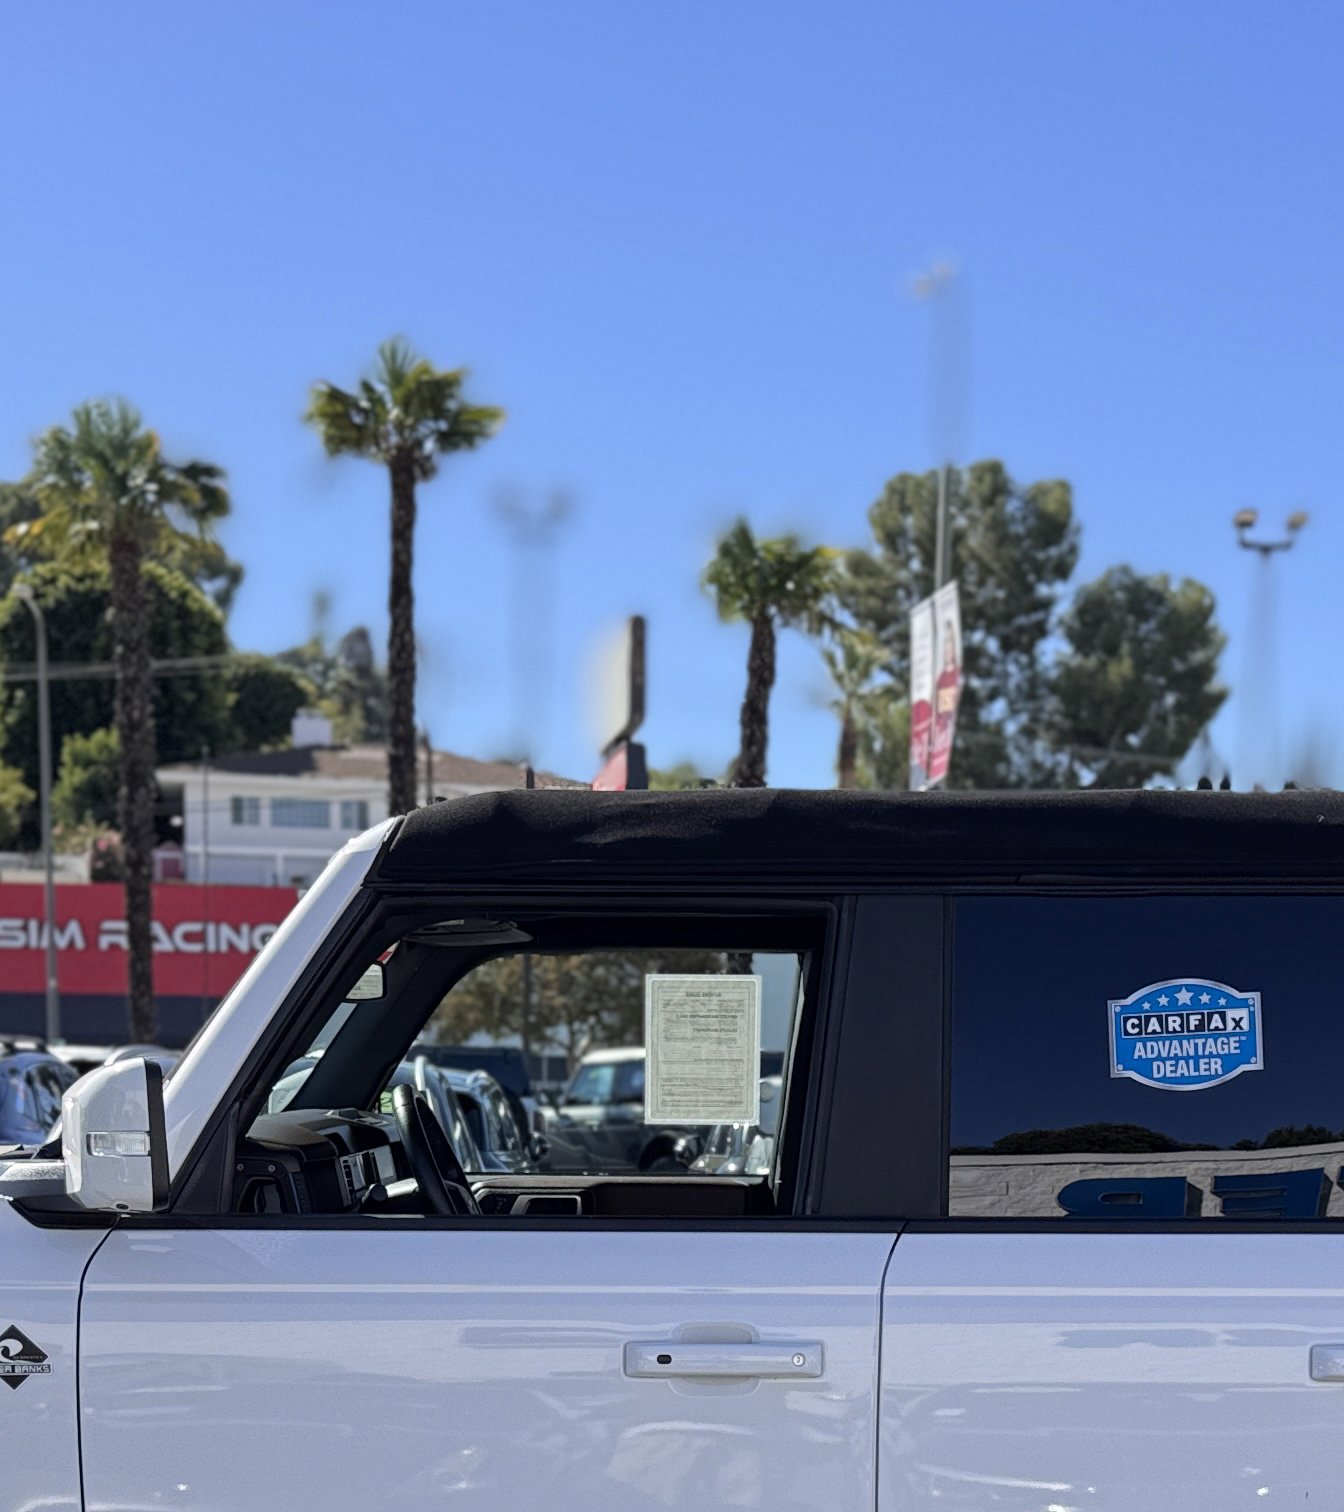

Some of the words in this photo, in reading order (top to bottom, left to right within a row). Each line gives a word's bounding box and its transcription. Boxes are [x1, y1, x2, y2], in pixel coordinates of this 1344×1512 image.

[1125, 1012, 1245, 1035] CARFAX
[1134, 1036, 1242, 1060] ADVANTAGE
[1153, 1058, 1223, 1079] DEALER
[15, 1364, 49, 1373] BANKS
